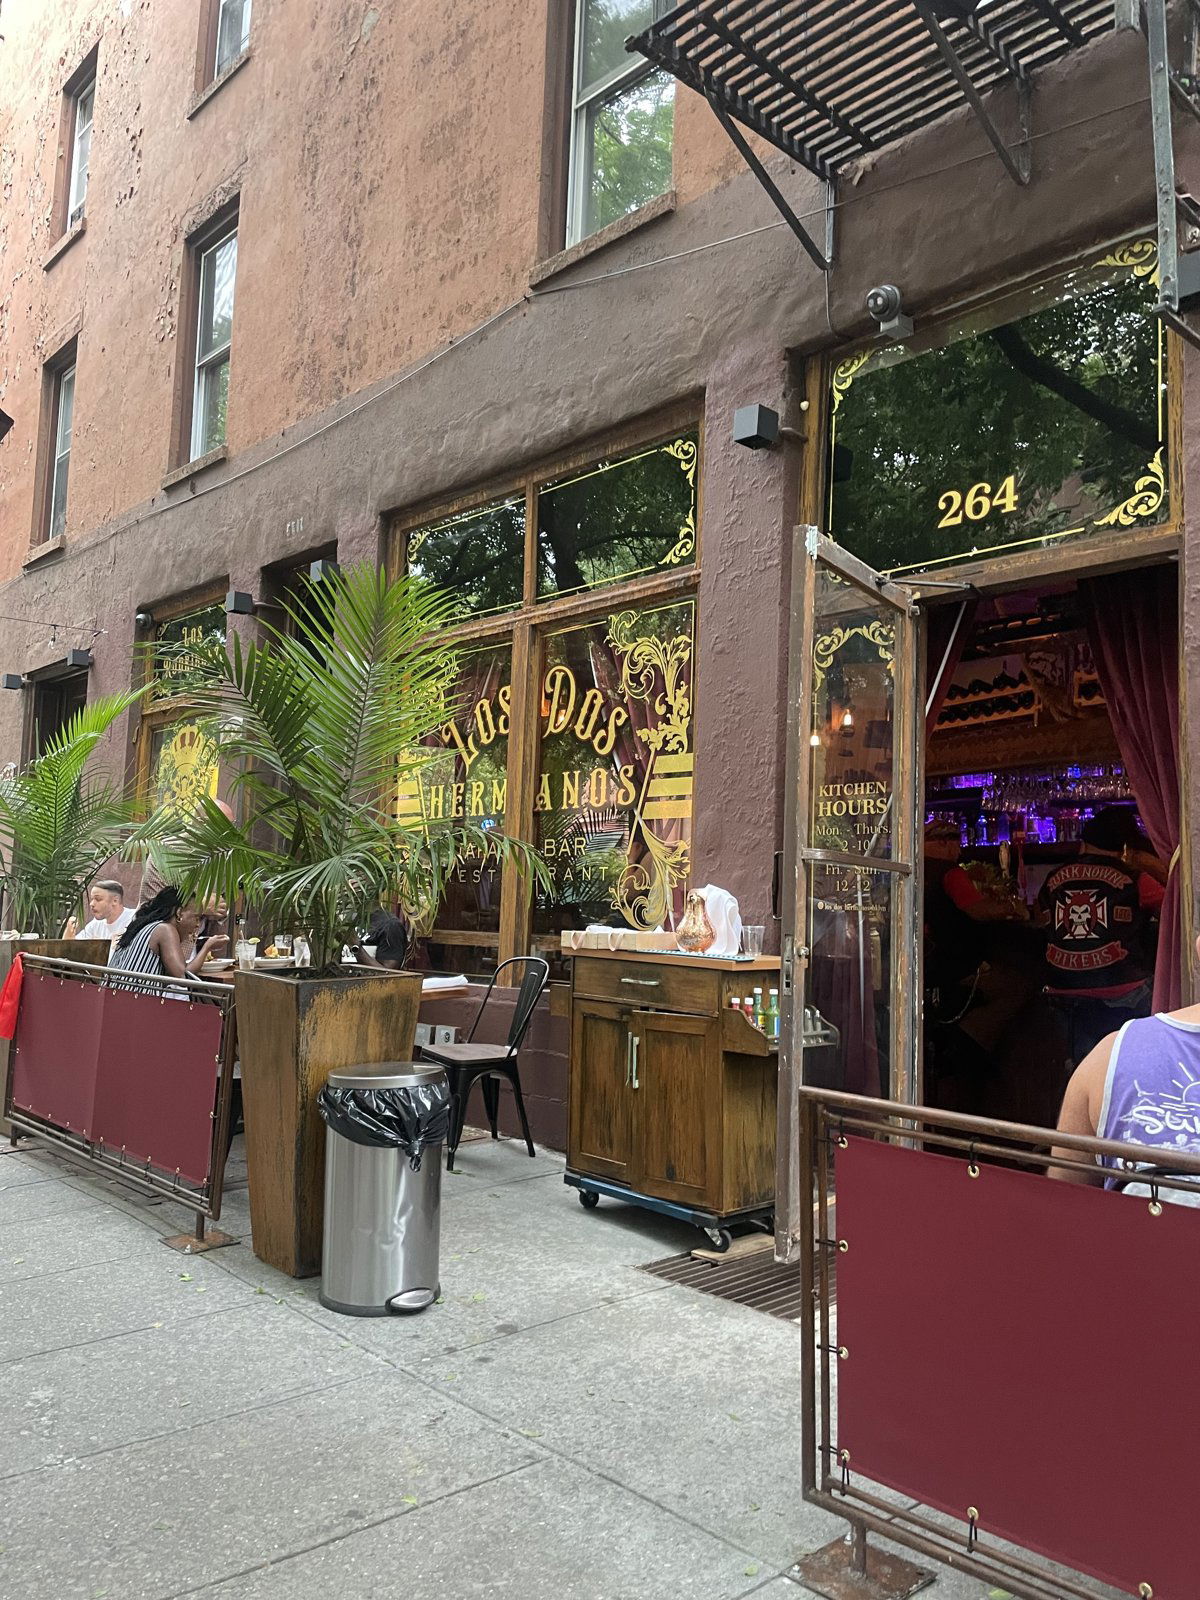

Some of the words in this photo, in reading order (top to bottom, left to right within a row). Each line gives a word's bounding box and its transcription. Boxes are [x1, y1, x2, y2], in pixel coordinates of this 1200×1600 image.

[938, 475, 1018, 528] 264
[543, 666, 628, 755] DOS
[820, 782, 887, 796] KITCHEN
[818, 798, 888, 817] HOURS
[816, 825, 843, 836] Mon.
[854, 823, 892, 835] Thurs.
[544, 837, 586, 857] BAR
[841, 839, 848, 851] 2
[858, 839, 870, 851] 10
[825, 863, 843, 875] Fri.
[836, 881, 848, 891] 12
[1053, 949, 1112, 967] BIKERS
